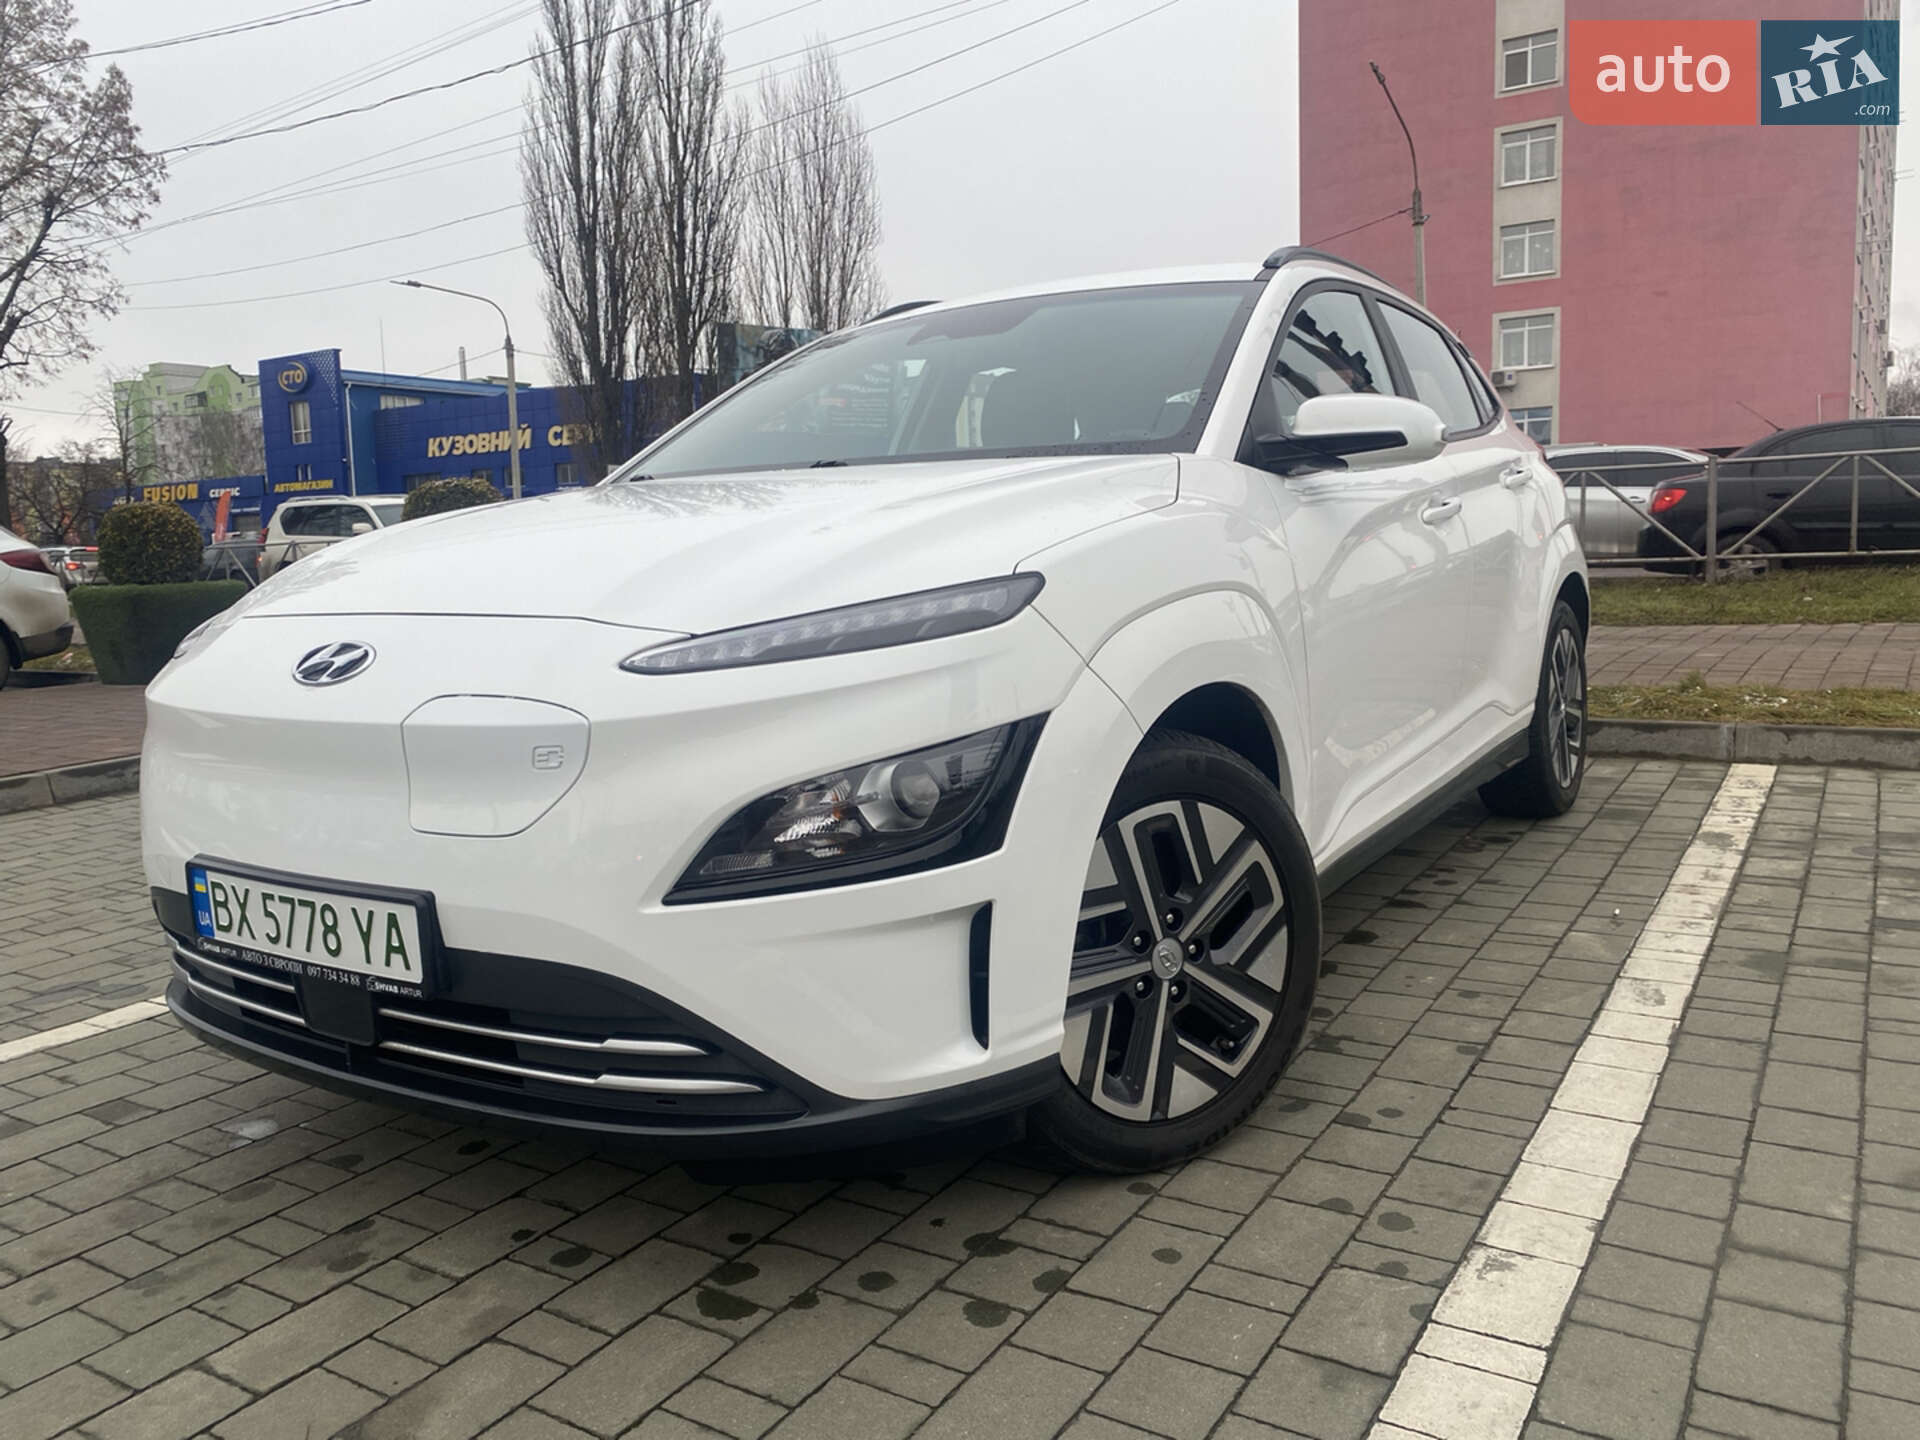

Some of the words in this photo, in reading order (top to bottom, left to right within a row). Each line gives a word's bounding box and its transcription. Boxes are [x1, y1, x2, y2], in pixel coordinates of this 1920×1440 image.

[282, 370, 303, 385] СТО
[427, 423, 532, 458] КУЗОВНИЙ
[143, 483, 198, 503] FUSION
[198, 910, 212, 928] UA
[210, 880, 256, 940] BX
[261, 892, 342, 958] 5778
[351, 907, 411, 971] YA
